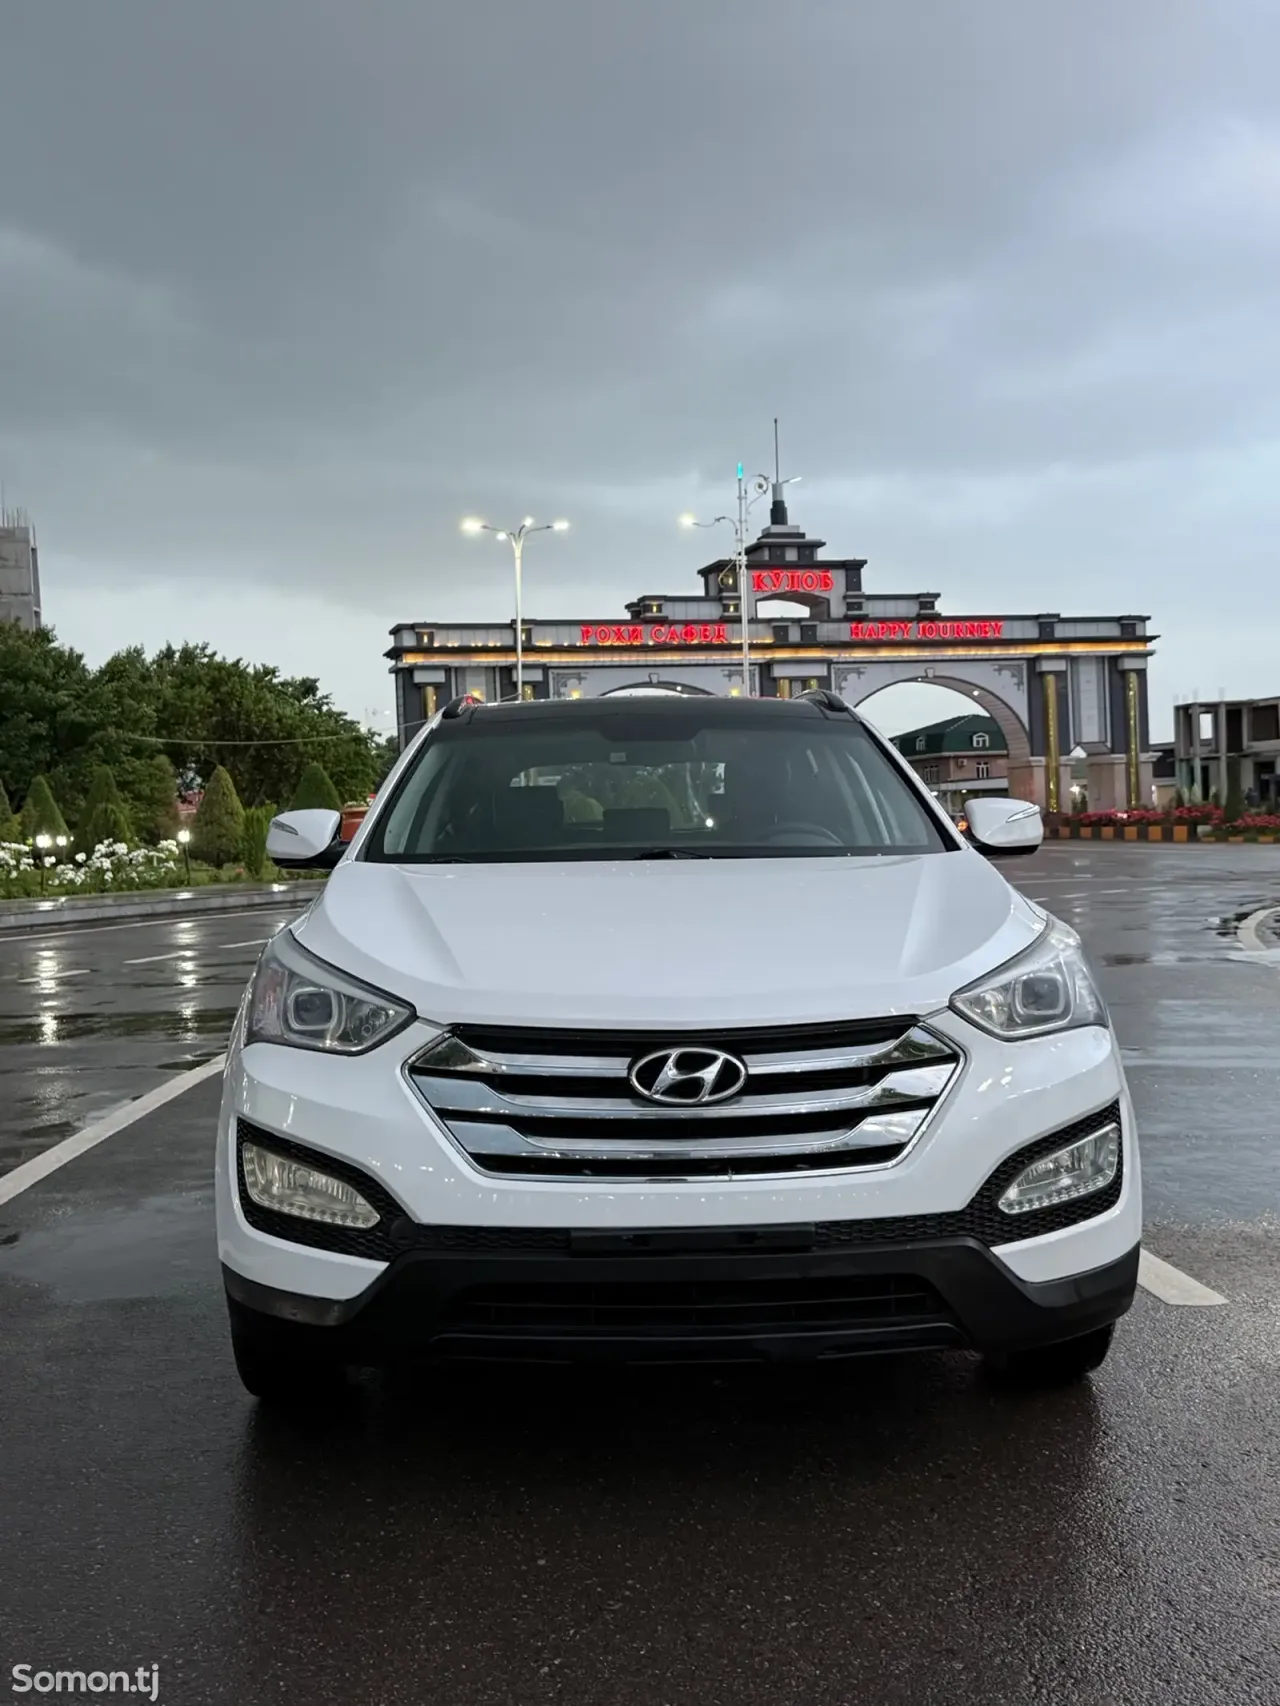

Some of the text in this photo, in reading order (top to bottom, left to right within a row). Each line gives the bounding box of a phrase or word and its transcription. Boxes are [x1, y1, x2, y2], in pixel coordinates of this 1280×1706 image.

[580, 624, 728, 645] РОХИ САФЕД
[849, 621, 1003, 640] HAPPY JOURNEY
